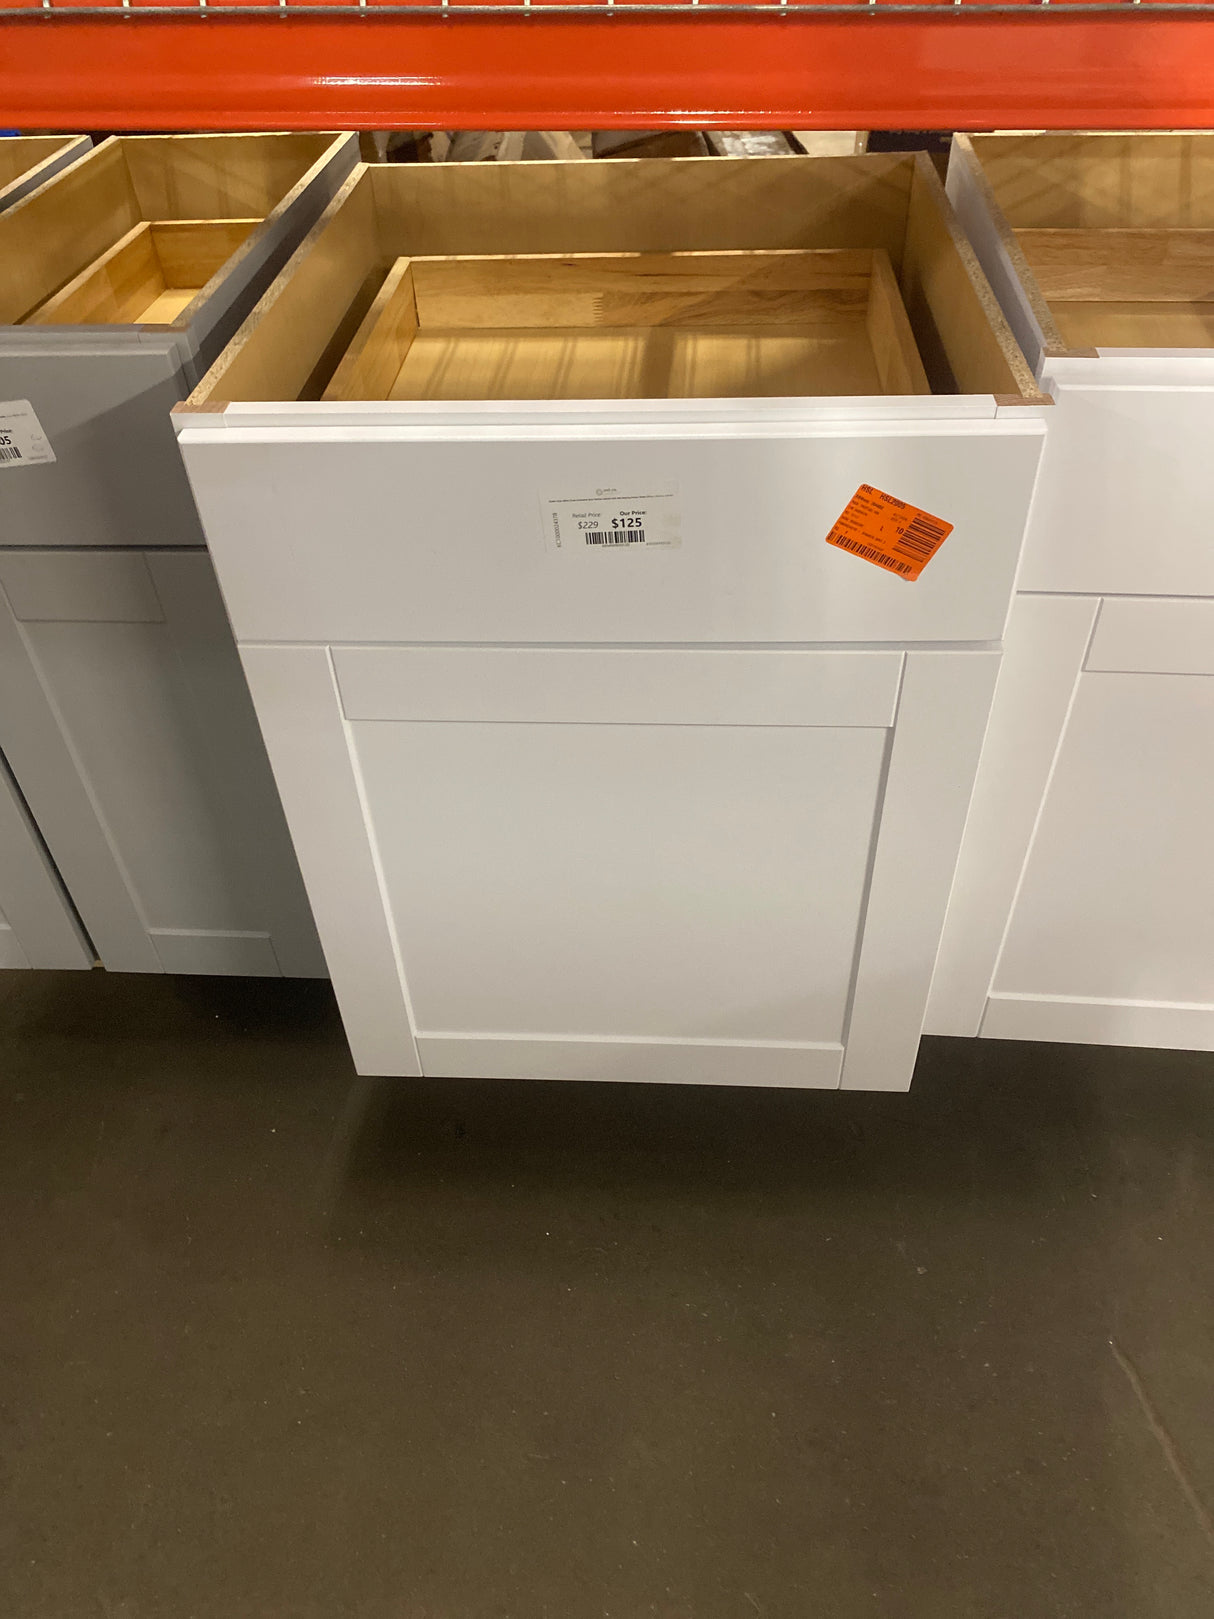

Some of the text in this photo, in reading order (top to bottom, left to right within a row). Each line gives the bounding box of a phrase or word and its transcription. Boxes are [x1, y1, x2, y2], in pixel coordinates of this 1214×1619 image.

[578, 517, 643, 530] $229 $125
[896, 526, 905, 535] 10
